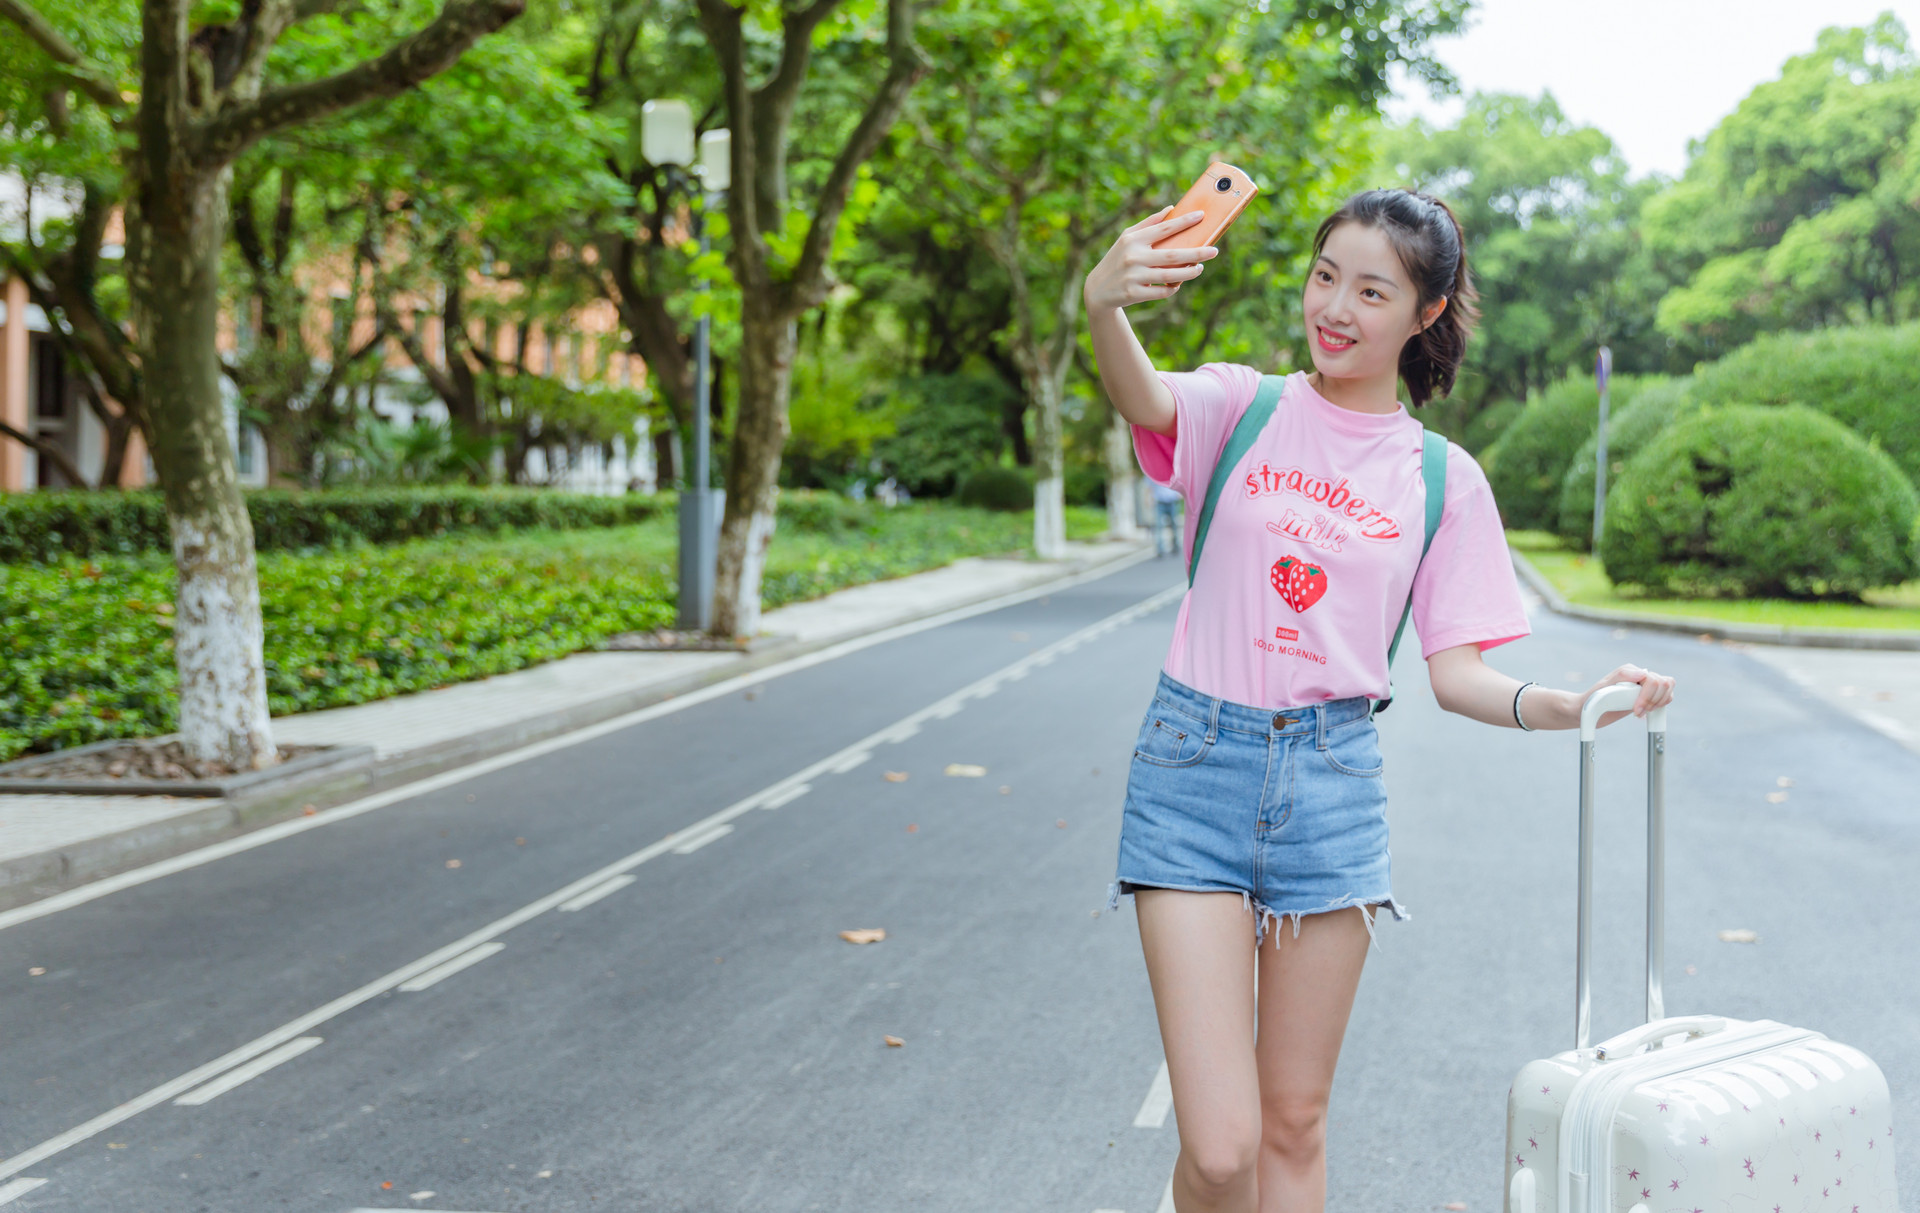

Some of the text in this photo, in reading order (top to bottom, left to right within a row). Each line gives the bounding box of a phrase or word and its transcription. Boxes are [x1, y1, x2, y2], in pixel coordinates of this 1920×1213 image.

[1246, 464, 1400, 539] strawberry
[1266, 508, 1349, 553] milk
[1254, 638, 1327, 665] OD MORNING
